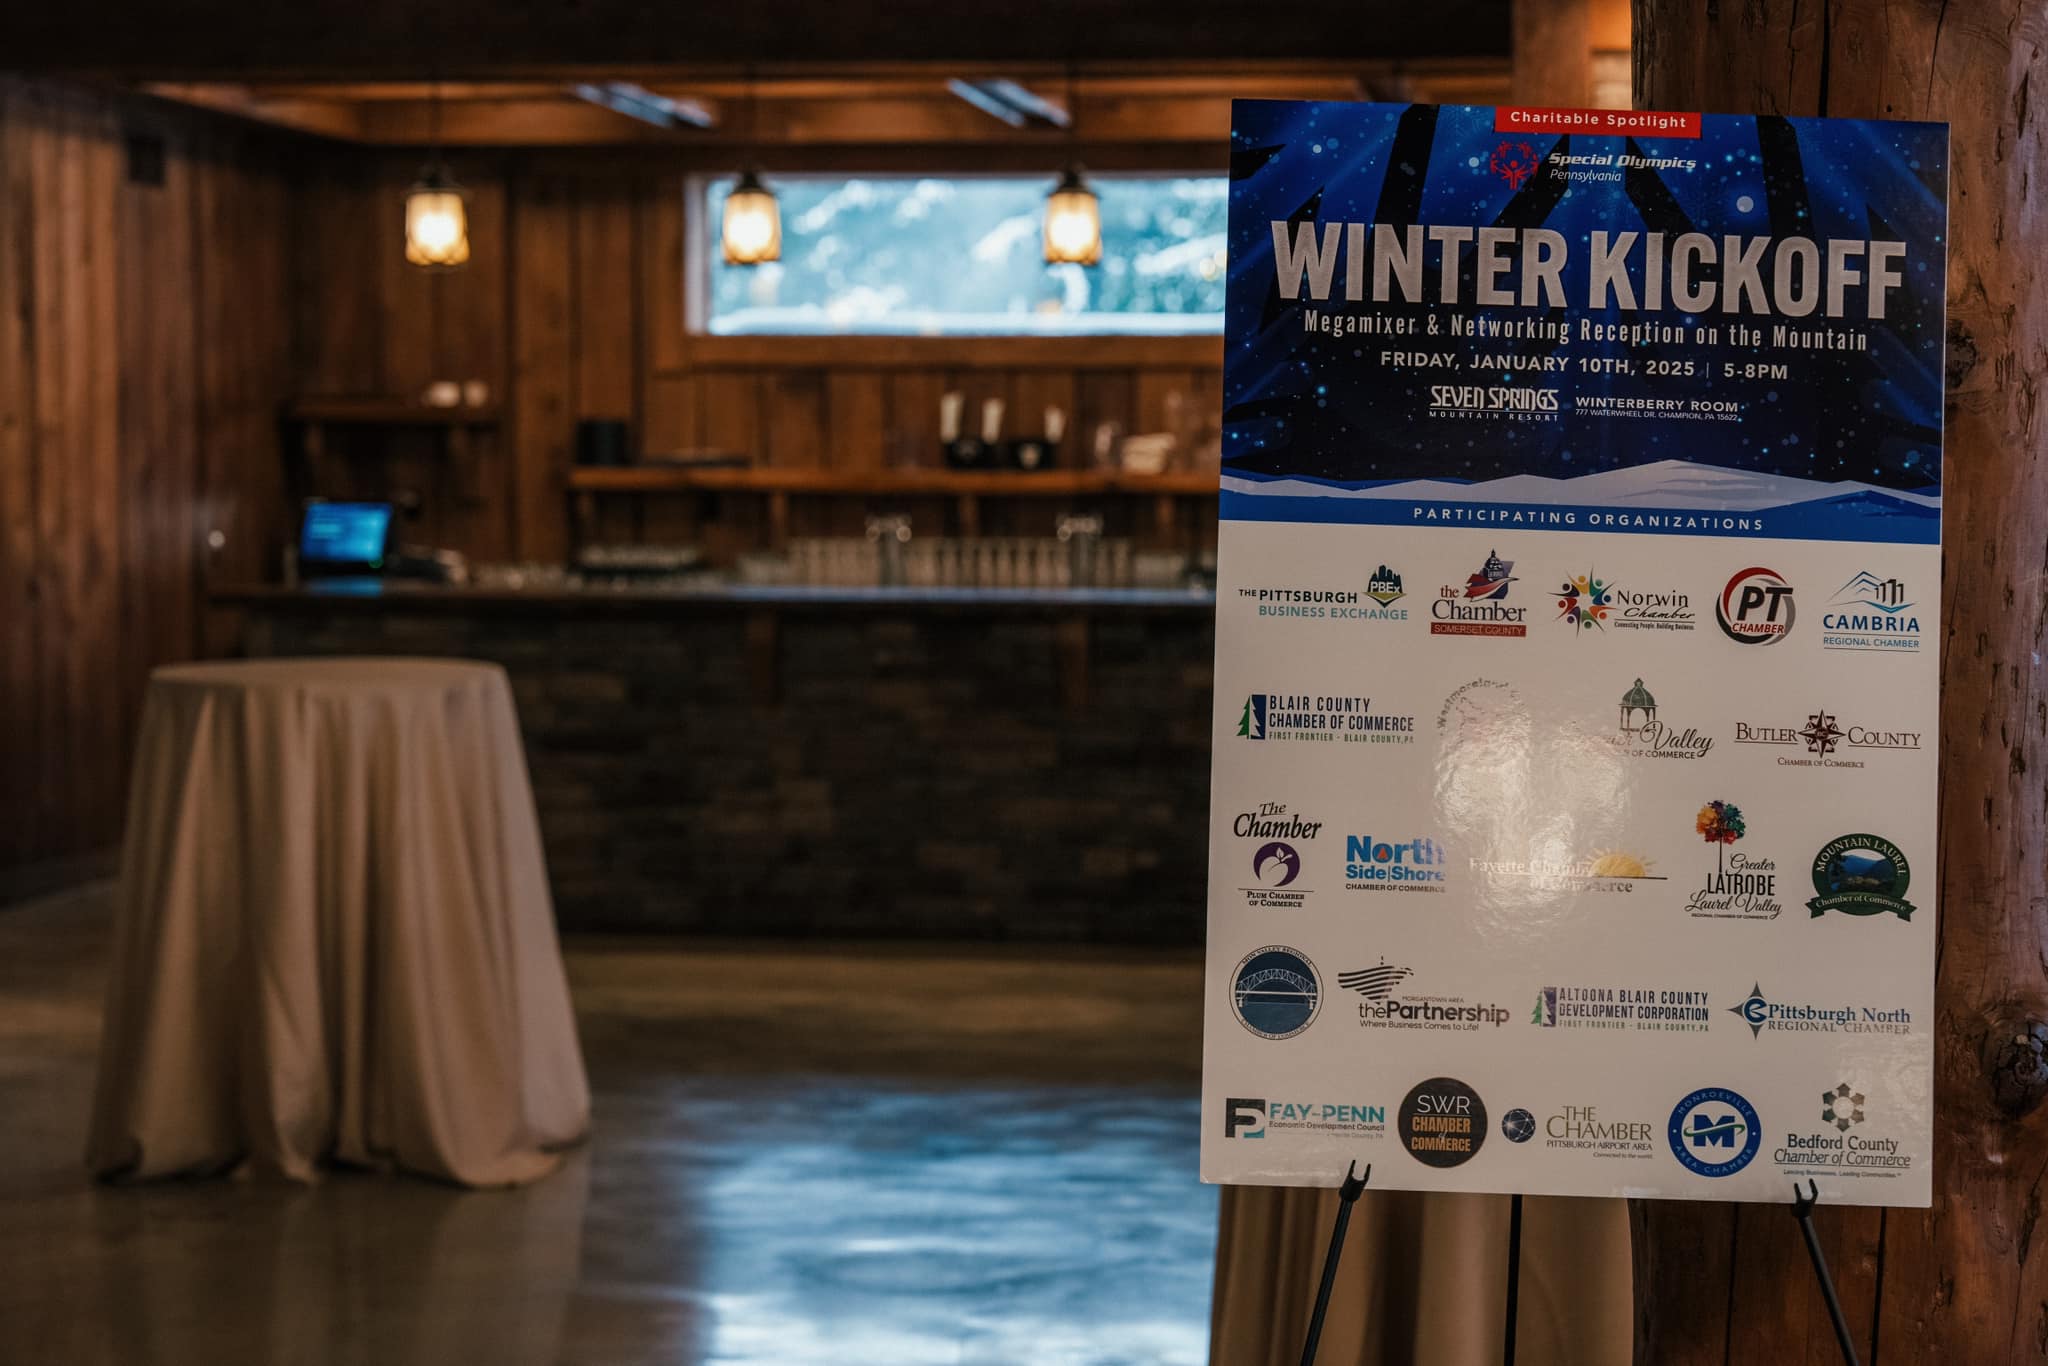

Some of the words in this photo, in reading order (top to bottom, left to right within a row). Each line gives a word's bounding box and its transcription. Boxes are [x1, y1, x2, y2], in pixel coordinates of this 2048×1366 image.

[1510, 110, 1600, 126] Charitable
[1607, 113, 1688, 131] Spotlight
[1549, 152, 1614, 168] Special
[1617, 155, 1697, 172] Olympics
[1549, 169, 1622, 184] Pennsylvania
[1271, 220, 1568, 308] WINTER
[1589, 230, 1907, 320] KICKOFF
[1304, 310, 1416, 338] Megamixer
[1426, 314, 1440, 335] &
[1451, 314, 1570, 345] Networking
[1580, 317, 1685, 346] Reception
[1696, 326, 1718, 345] on
[1730, 323, 1761, 347] the
[1773, 325, 1867, 350] Mountain
[1381, 351, 1461, 371] FRIDAY,
[1470, 353, 1569, 373] JANUARY
[1578, 357, 1637, 377] 10TH,
[1646, 360, 1695, 376] 2025
[1723, 363, 1788, 380] 5-8PM
[1430, 385, 1484, 409] SEVEN
[1487, 387, 1560, 411] SPRINGS
[1576, 397, 1685, 410] WINTERBERRY
[1691, 401, 1738, 412] ROOM
[1429, 411, 1499, 420] MOUNTAIN
[1509, 412, 1559, 421] RESORT
[1575, 408, 1588, 416] 777
[1590, 409, 1642, 418] WATERWHEEL
[1705, 413, 1715, 421] PA
[1717, 413, 1738, 421] 15622
[1414, 507, 1576, 524] PARTICIPATING
[1589, 513, 1763, 531] ORGANIZATIONS
[1239, 588, 1257, 597] THE
[1259, 589, 1358, 604] PITTSBURGH
[1370, 581, 1401, 593] PBEx
[1440, 585, 1460, 598] the
[1617, 590, 1689, 607] Norwin
[1736, 585, 1793, 622] PT
[1259, 605, 1326, 618] BUSINESS
[1330, 607, 1408, 621] EXCHANGE
[1432, 599, 1527, 622] Chamber
[1624, 603, 1695, 619] Chamber
[1435, 624, 1483, 634] SOMERSET
[1485, 625, 1522, 635] COUNTY
[1731, 622, 1785, 634] CHAMBER
[1823, 614, 1920, 632] CAMBRIA
[1823, 636, 1871, 647] REGIONAL
[1873, 637, 1919, 648] CHAMBER
[1270, 695, 1309, 711] BLAIR
[1317, 697, 1371, 713] COUNTY
[1269, 713, 1326, 729] CHAMBER
[1330, 715, 1345, 730] OF
[1348, 715, 1414, 732] COMMERCE
[1269, 731, 1292, 740] FIRST
[1295, 732, 1334, 741] FRONTIER
[1344, 733, 1367, 742] BLAIR
[1640, 720, 1715, 758] Valley
[1735, 722, 1798, 742] BUTLER
[1847, 726, 1920, 746] COUNTY
[1645, 750, 1695, 759] COMMERCE
[1260, 801, 1287, 817] The
[1233, 813, 1322, 839] Chamber
[1346, 835, 1445, 865] North
[1816, 837, 1872, 872] MOUNTAIN
[1874, 840, 1907, 877] LAUREL
[1727, 853, 1777, 873] Greater
[1346, 883, 1386, 891] CHAMBER
[1387, 883, 1398, 891] OF
[1398, 884, 1445, 894] COMMERCE
[1707, 872, 1776, 896] LATROBE
[1684, 889, 1732, 912] Laurel
[1734, 895, 1783, 920] Valley
[1816, 895, 1852, 908] Chamber
[1864, 896, 1906, 911] Commerce
[1559, 987, 1613, 1002] ALTOONA
[1619, 989, 1655, 1004] BLAIR
[1661, 991, 1708, 1006] COUNTY
[1358, 1000, 1511, 1027] thePartnership
[1559, 1003, 1634, 1018] DEVELOPMENT
[1637, 1006, 1709, 1021] CORPORATION
[1768, 1003, 1856, 1025] Pittsburgh
[1862, 1007, 1911, 1024] North
[1360, 1020, 1387, 1028] Where
[1388, 1021, 1423, 1029] Business
[1424, 1022, 1451, 1030] Comes
[1463, 1023, 1479, 1031] Life!
[1767, 1021, 1837, 1033] REGIONAL
[1844, 1022, 1911, 1035] CHAMBER
[1417, 1094, 1471, 1114] SWR
[1677, 1091, 1752, 1116] MONROEVILLE
[1269, 1103, 1385, 1123] FAY-PENN
[1562, 1105, 1597, 1122] THE
[1269, 1120, 1305, 1129] Economic
[1306, 1121, 1355, 1131] Development
[1357, 1123, 1385, 1131] Council
[1412, 1116, 1471, 1133] CHAMBER
[1546, 1115, 1653, 1141] CHAMBER
[1411, 1136, 1471, 1152] COMMERCE
[1546, 1139, 1596, 1150] PITTSBURGH
[1597, 1141, 1631, 1151] AIRPORT
[1631, 1142, 1653, 1151] AREA
[1787, 1133, 1843, 1150] Bedford
[1848, 1136, 1899, 1155] County
[1774, 1148, 1830, 1163] Chamber
[1831, 1150, 1845, 1167] of
[1846, 1151, 1911, 1167] Commerce
